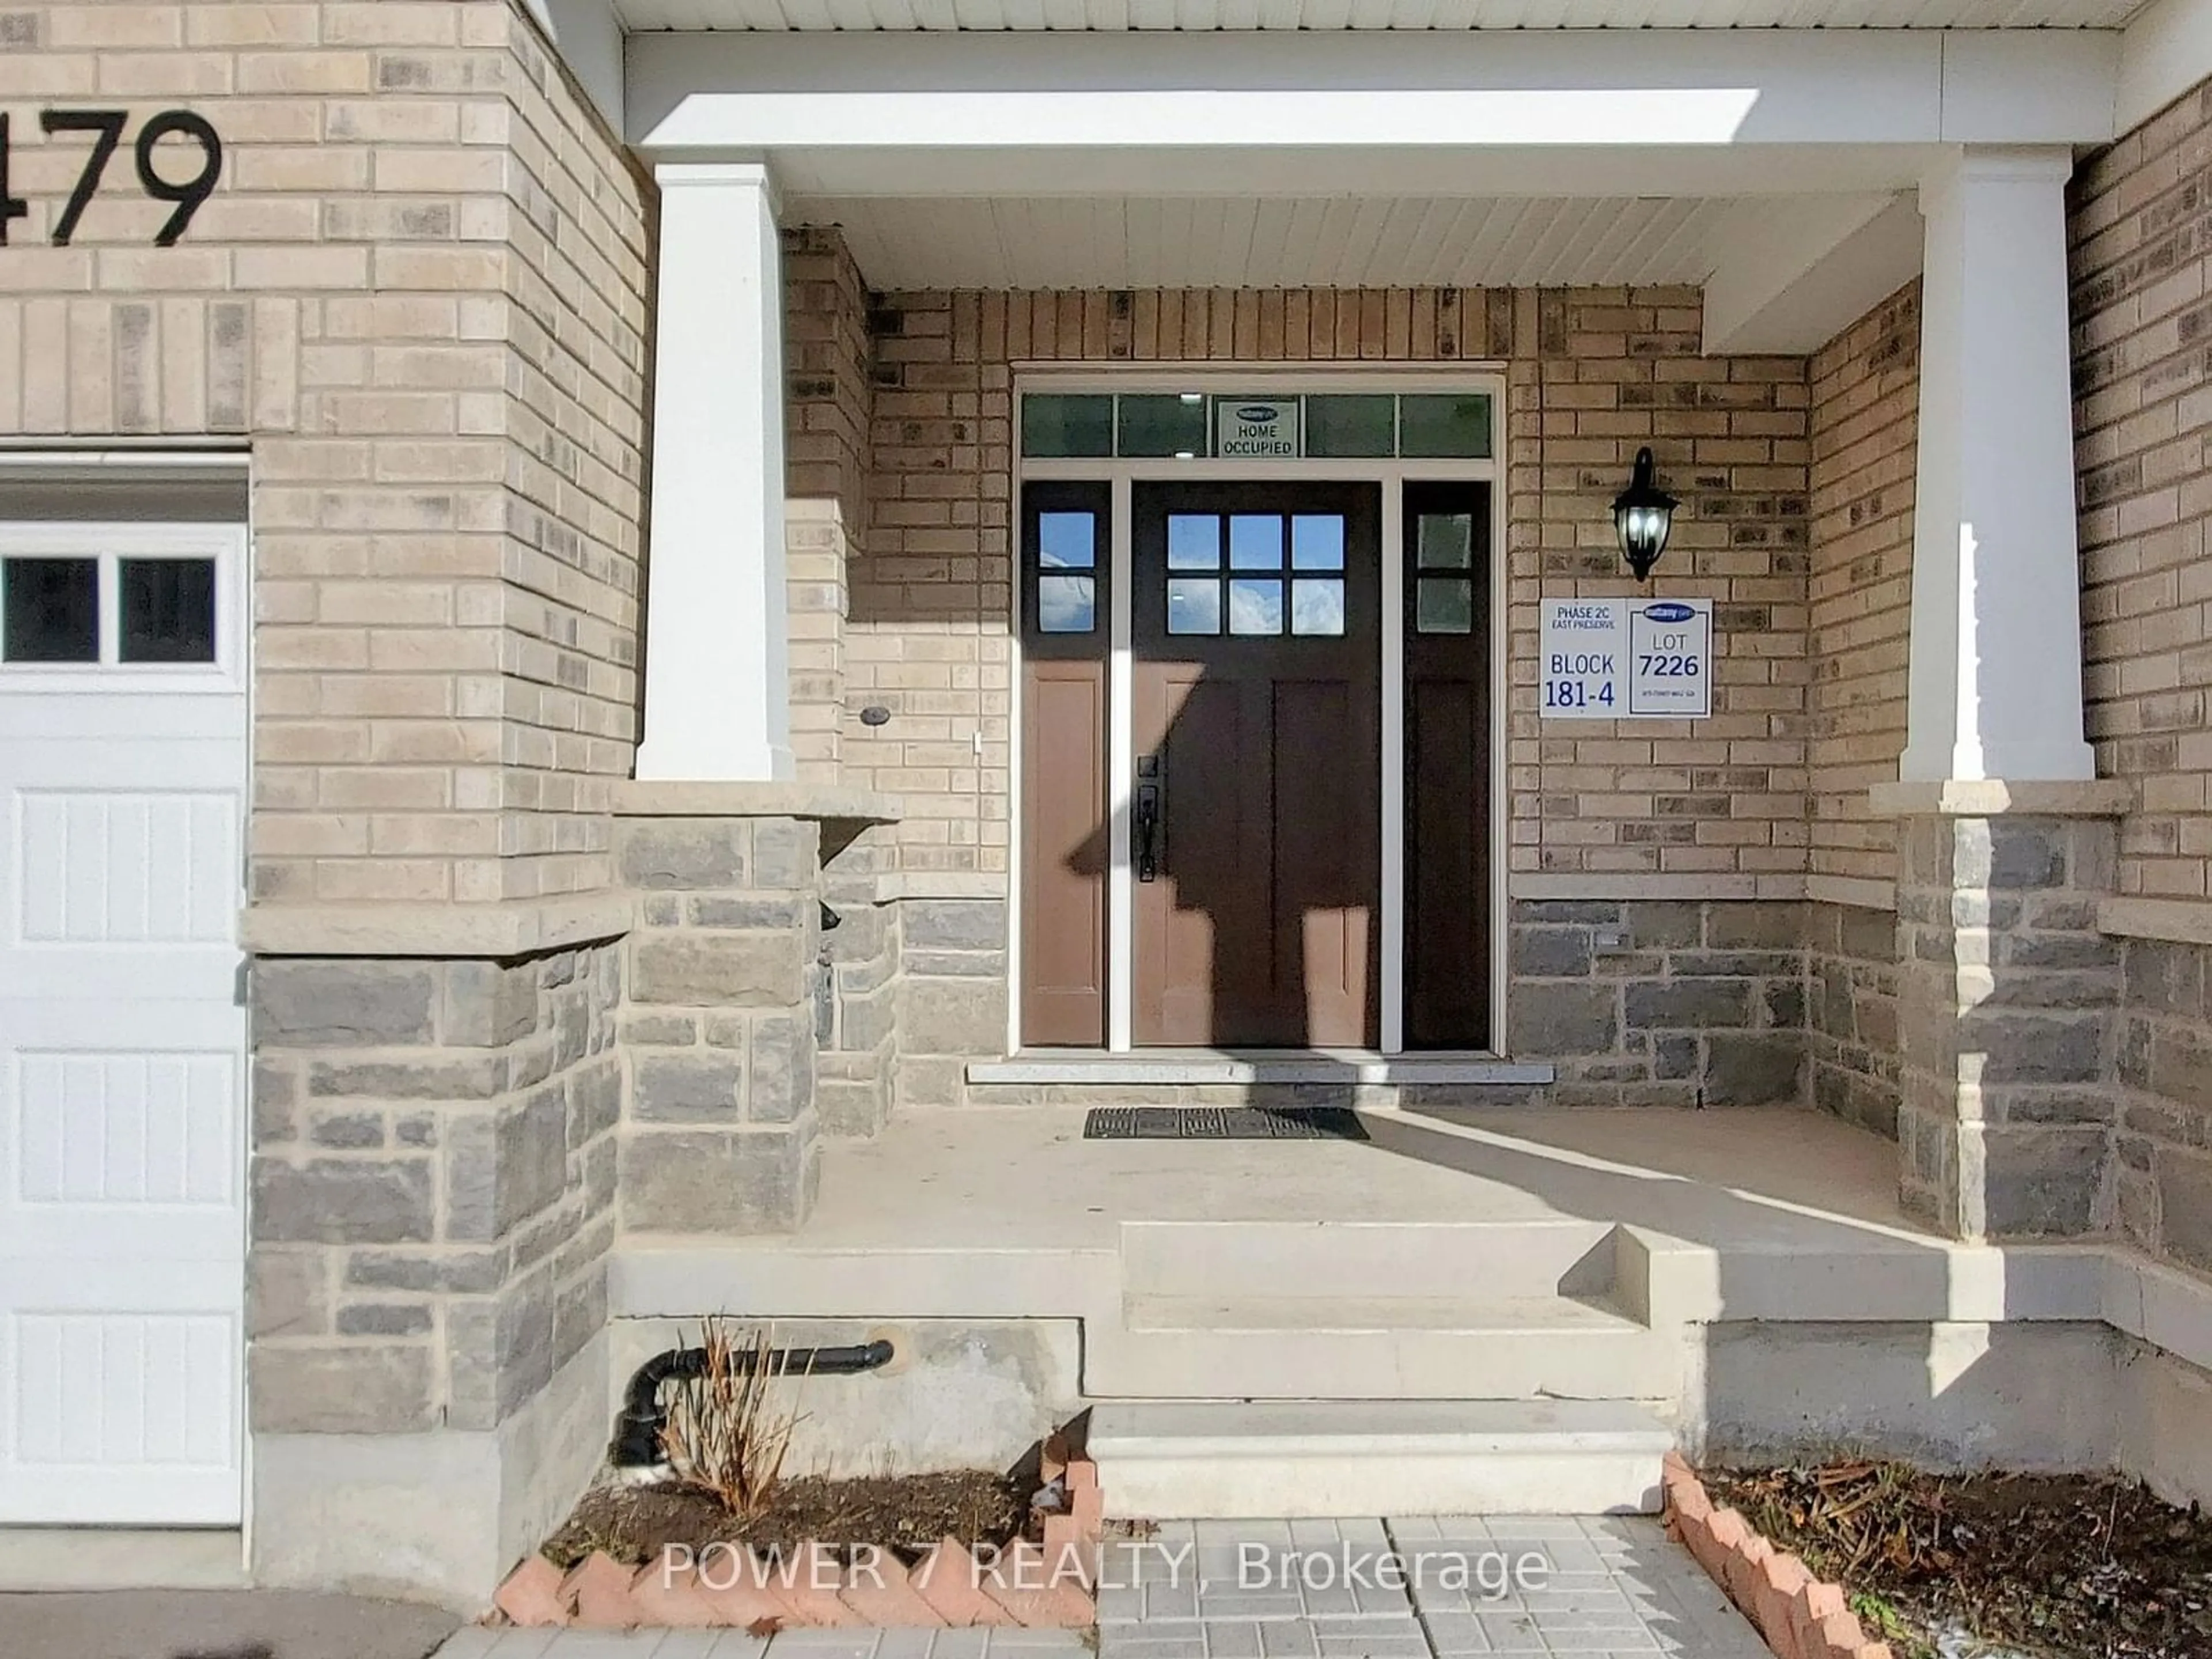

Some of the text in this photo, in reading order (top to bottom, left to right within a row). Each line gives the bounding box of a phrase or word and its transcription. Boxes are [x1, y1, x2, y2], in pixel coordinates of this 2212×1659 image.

[1238, 425, 1278, 438] HOME
[1224, 441, 1291, 454] OCCUPIED
[1558, 607, 1609, 619] PHASE 2C
[1653, 634, 1688, 650] LOT
[1551, 654, 1615, 675] BLOCK
[1639, 655, 1699, 676] 7226
[1545, 680, 1615, 707] 181-4
